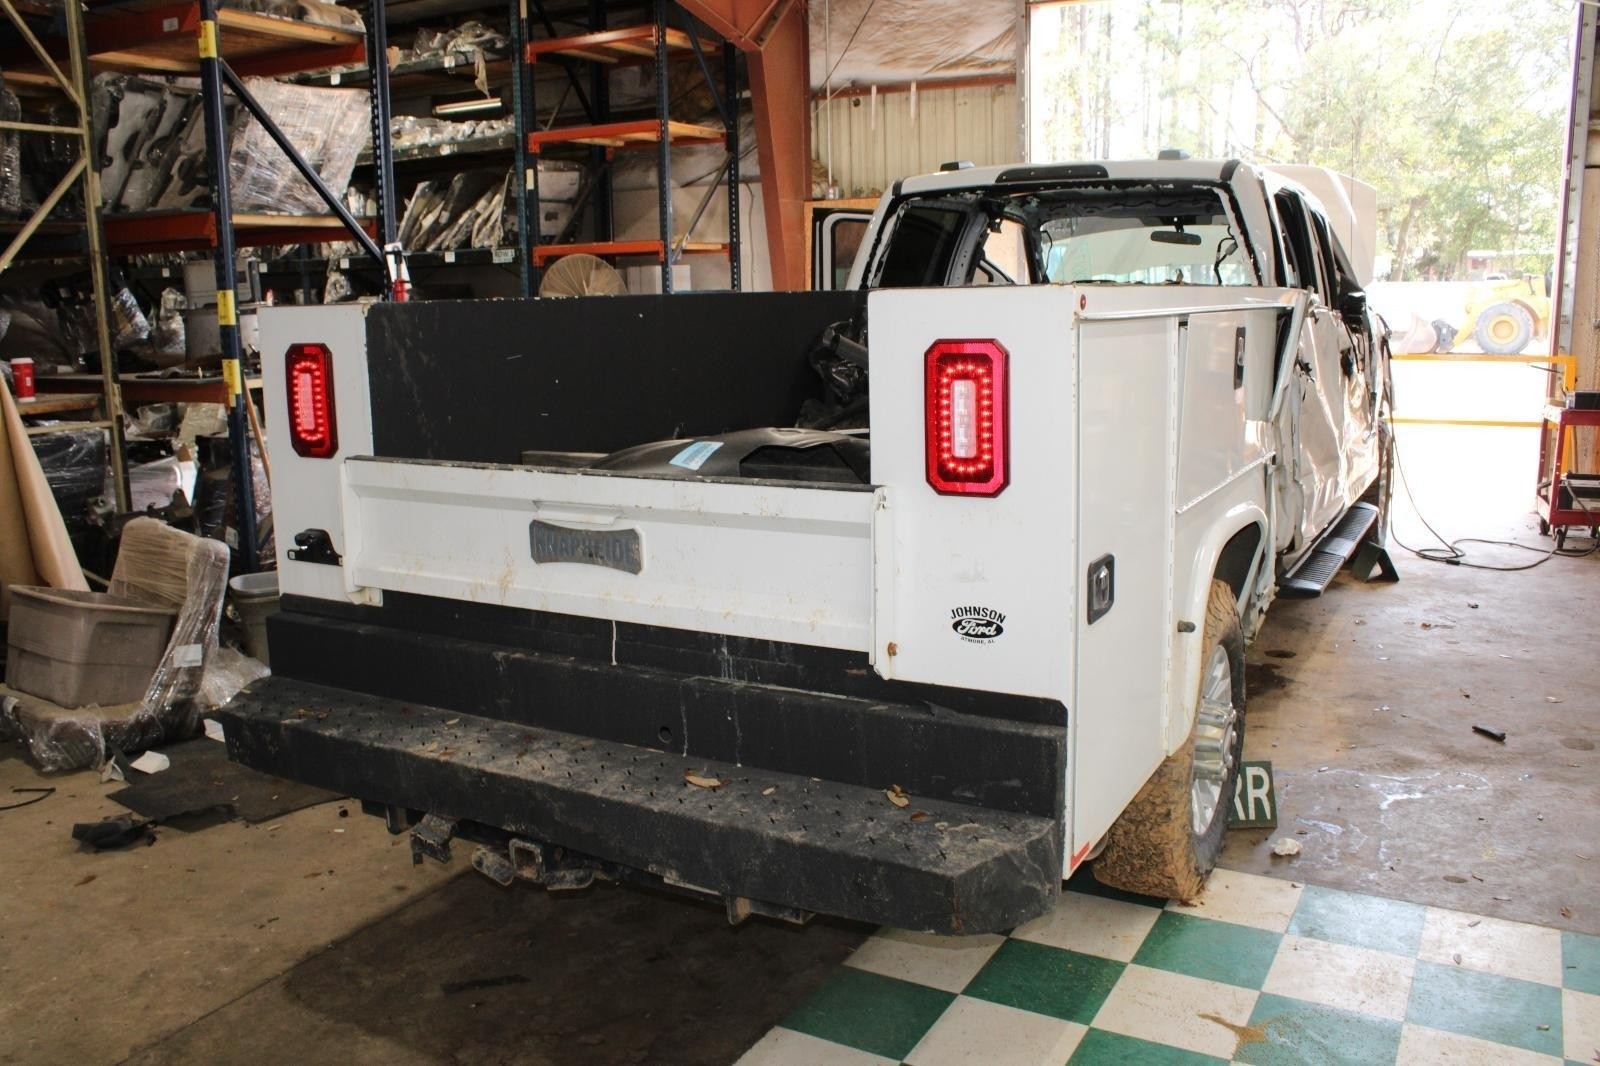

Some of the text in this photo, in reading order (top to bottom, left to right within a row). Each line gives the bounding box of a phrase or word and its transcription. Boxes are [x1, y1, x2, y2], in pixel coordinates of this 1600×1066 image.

[534, 524, 635, 566] KNAPHEIDE
[951, 606, 1006, 624] JOHNSON
[957, 619, 997, 636] Ford
